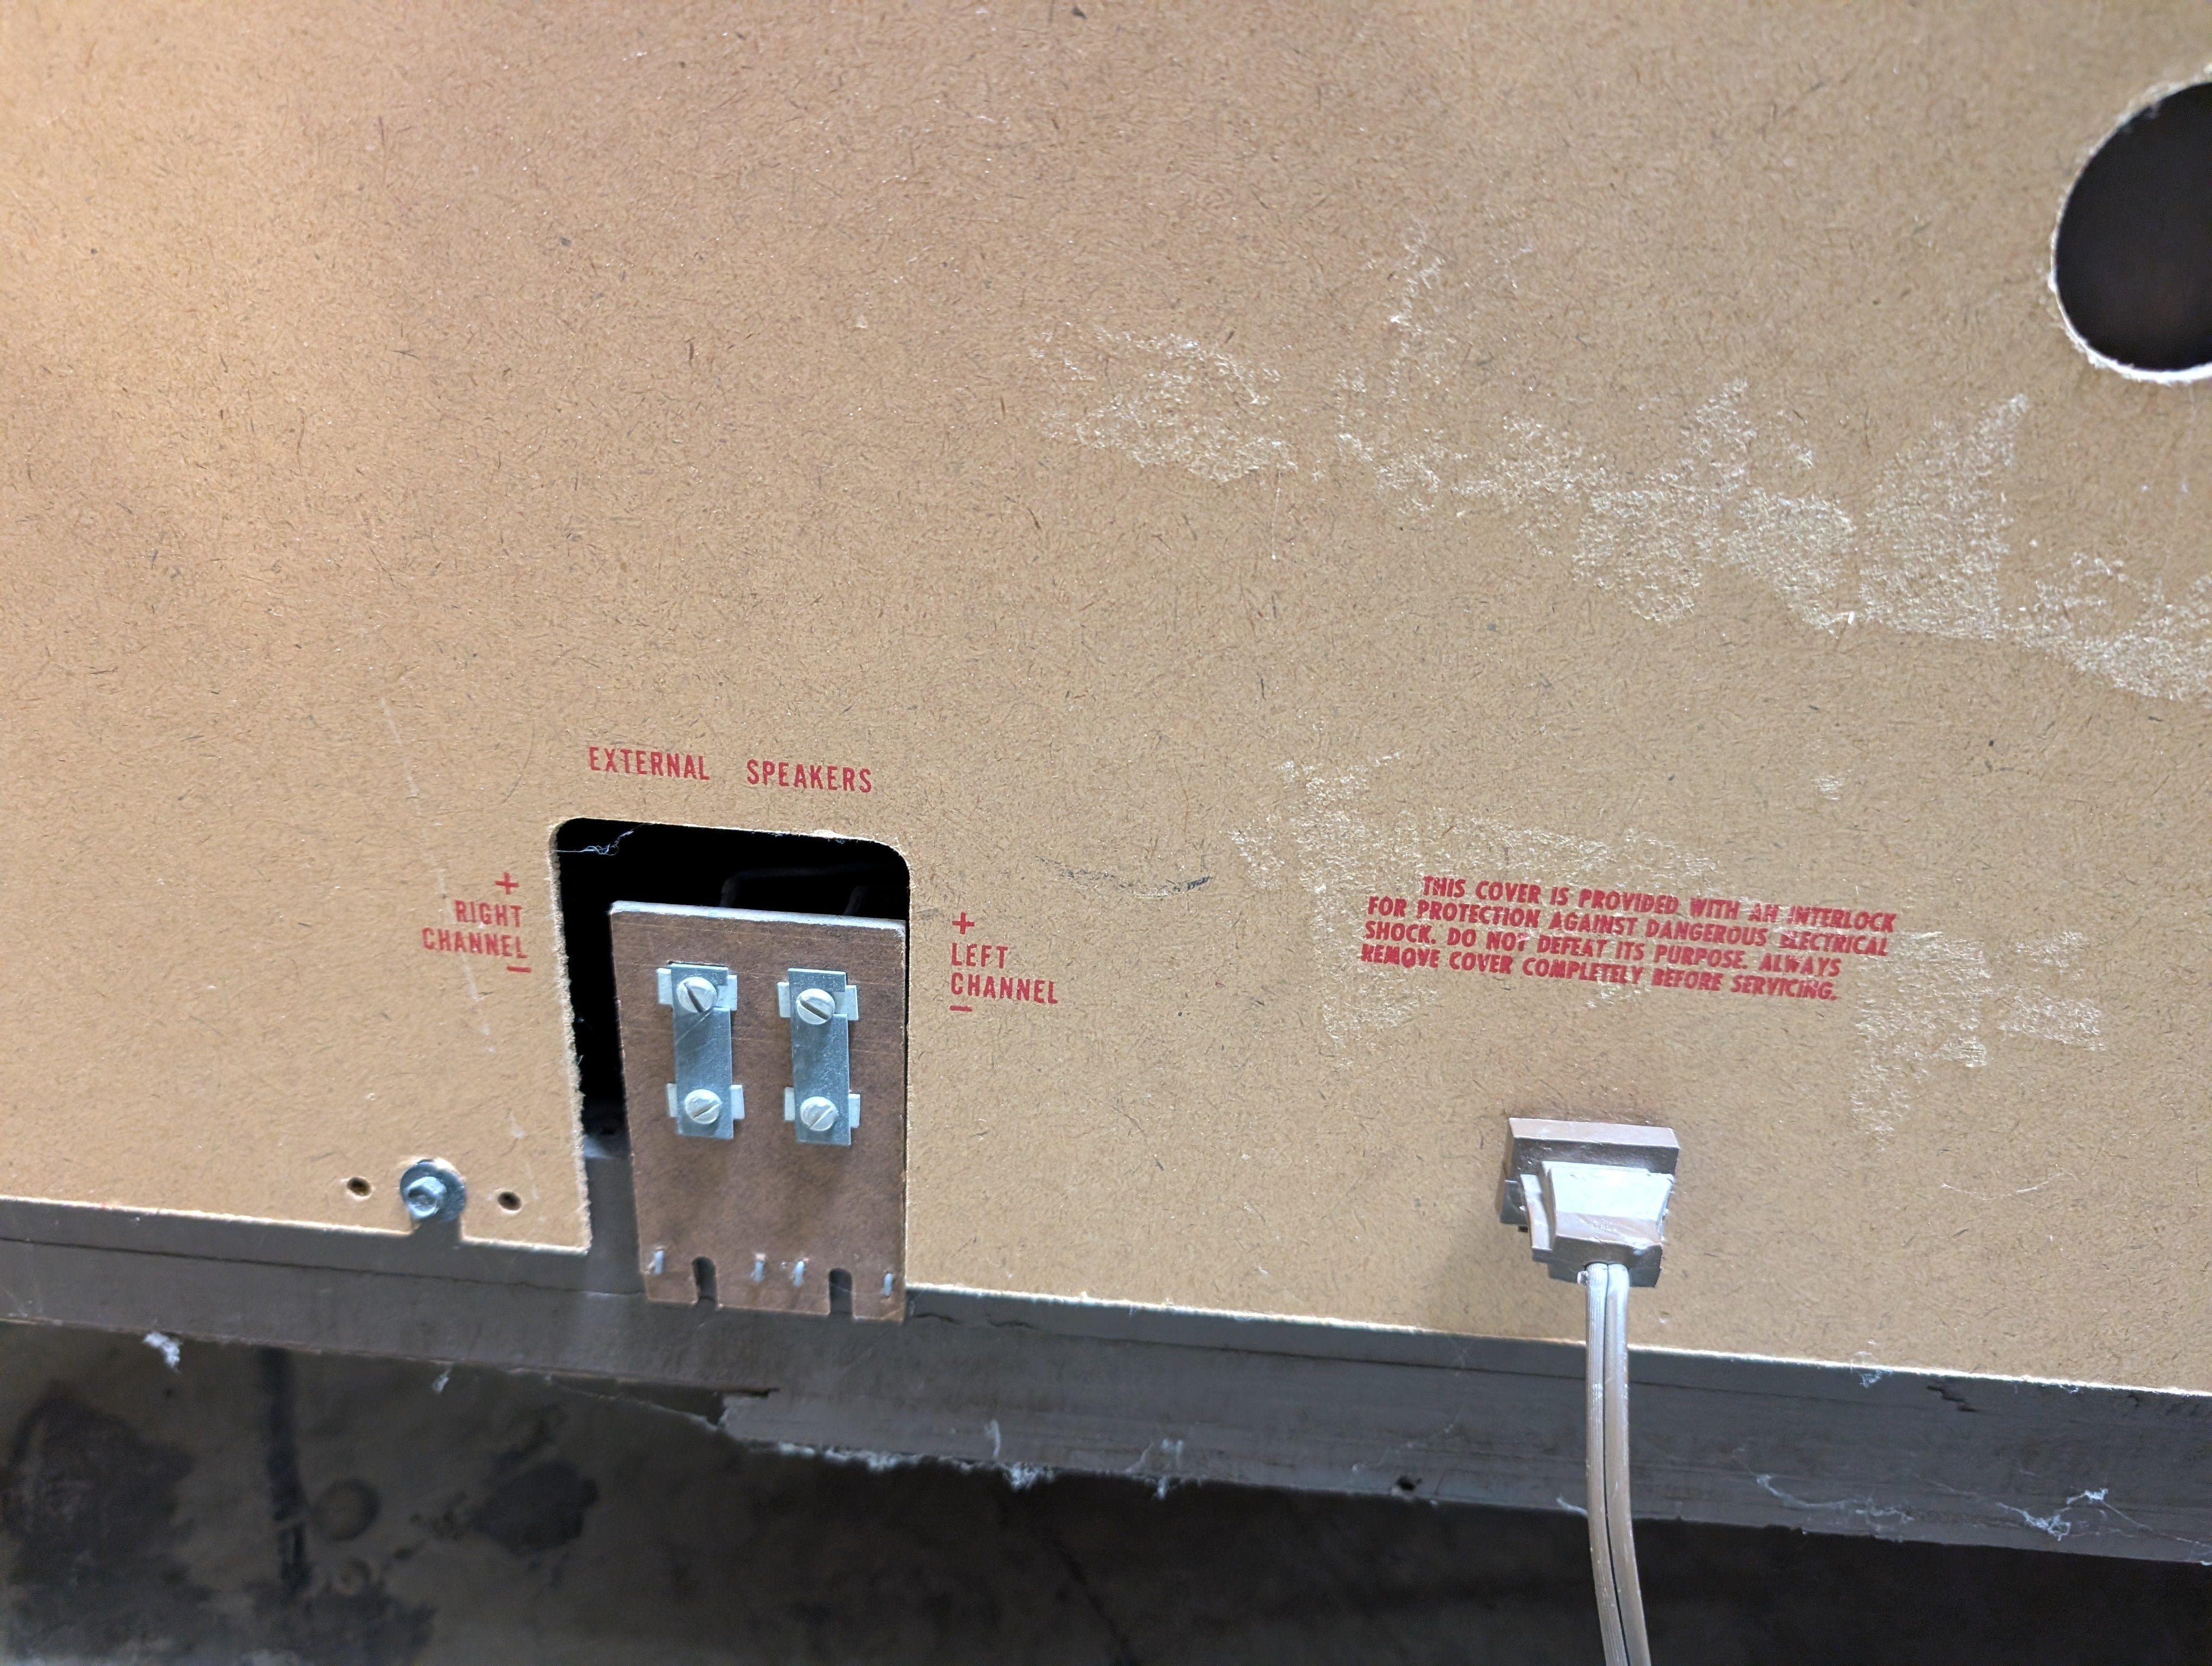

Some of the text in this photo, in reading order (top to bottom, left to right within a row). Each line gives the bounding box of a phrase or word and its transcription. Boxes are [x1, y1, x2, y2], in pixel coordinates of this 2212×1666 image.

[589, 746, 872, 793] EXTERNAL SPEAKERS
[454, 900, 522, 927] RIGHT
[1368, 896, 1888, 957] FOR PROTECTION AGAINST DANGEROUS ELECTRICAL
[1423, 876, 1466, 898] THIS
[1475, 881, 1541, 904] COVER
[1550, 887, 1570, 906] IS
[1578, 889, 1679, 915] PROVIDED
[1690, 898, 1741, 920] WITH
[1786, 906, 1896, 933] INTERLOCK
[422, 927, 528, 959] CHANNEL
[951, 943, 1008, 969] LEFT
[1365, 920, 1842, 977] SHOCK. DO NOT DEFEAT ITS PURPOSE. ALWAYS
[951, 972, 1058, 1004] CHANNEL
[1449, 951, 1513, 975] COVER
[1522, 957, 1645, 985] COMPLETELY
[1652, 967, 1724, 991] BEFORE
[1731, 975, 1837, 1001] SERVICING.
